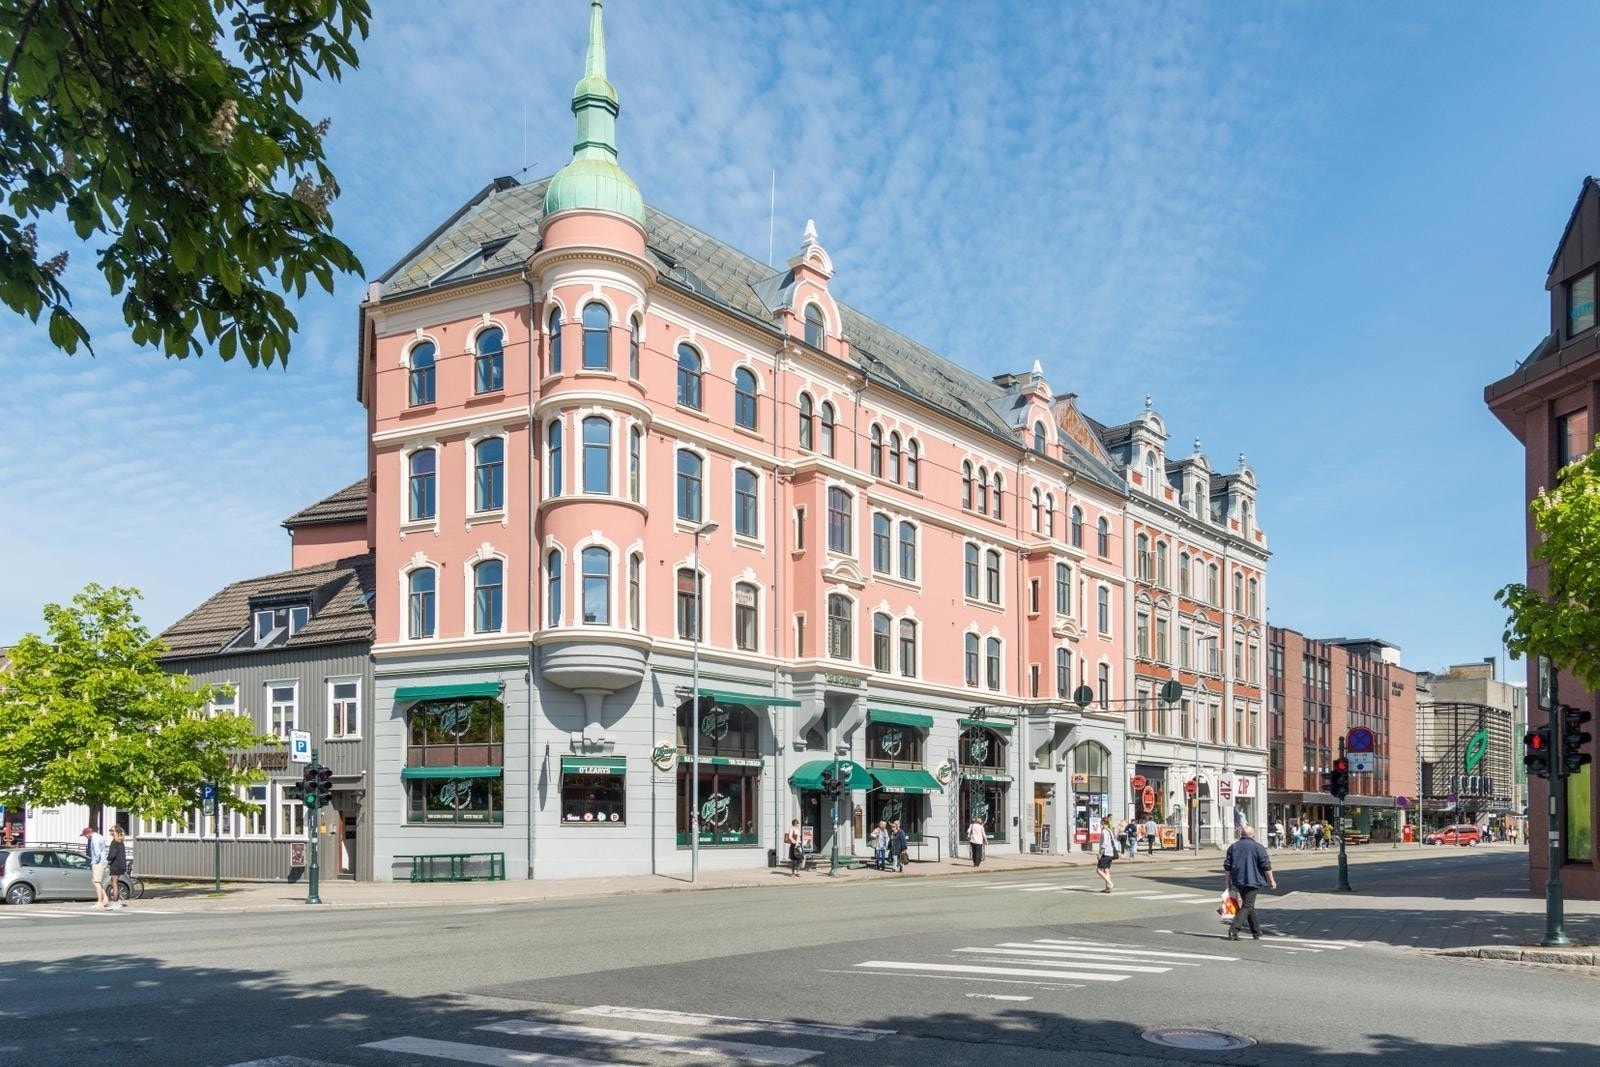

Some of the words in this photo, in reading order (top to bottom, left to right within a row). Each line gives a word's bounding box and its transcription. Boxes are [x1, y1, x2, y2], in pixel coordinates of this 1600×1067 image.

[298, 741, 305, 751] P
[579, 767, 611, 775] O'LEARYS
[1220, 780, 1233, 800] ZIP
[1238, 776, 1250, 795] ZIP
[205, 786, 212, 798] P
